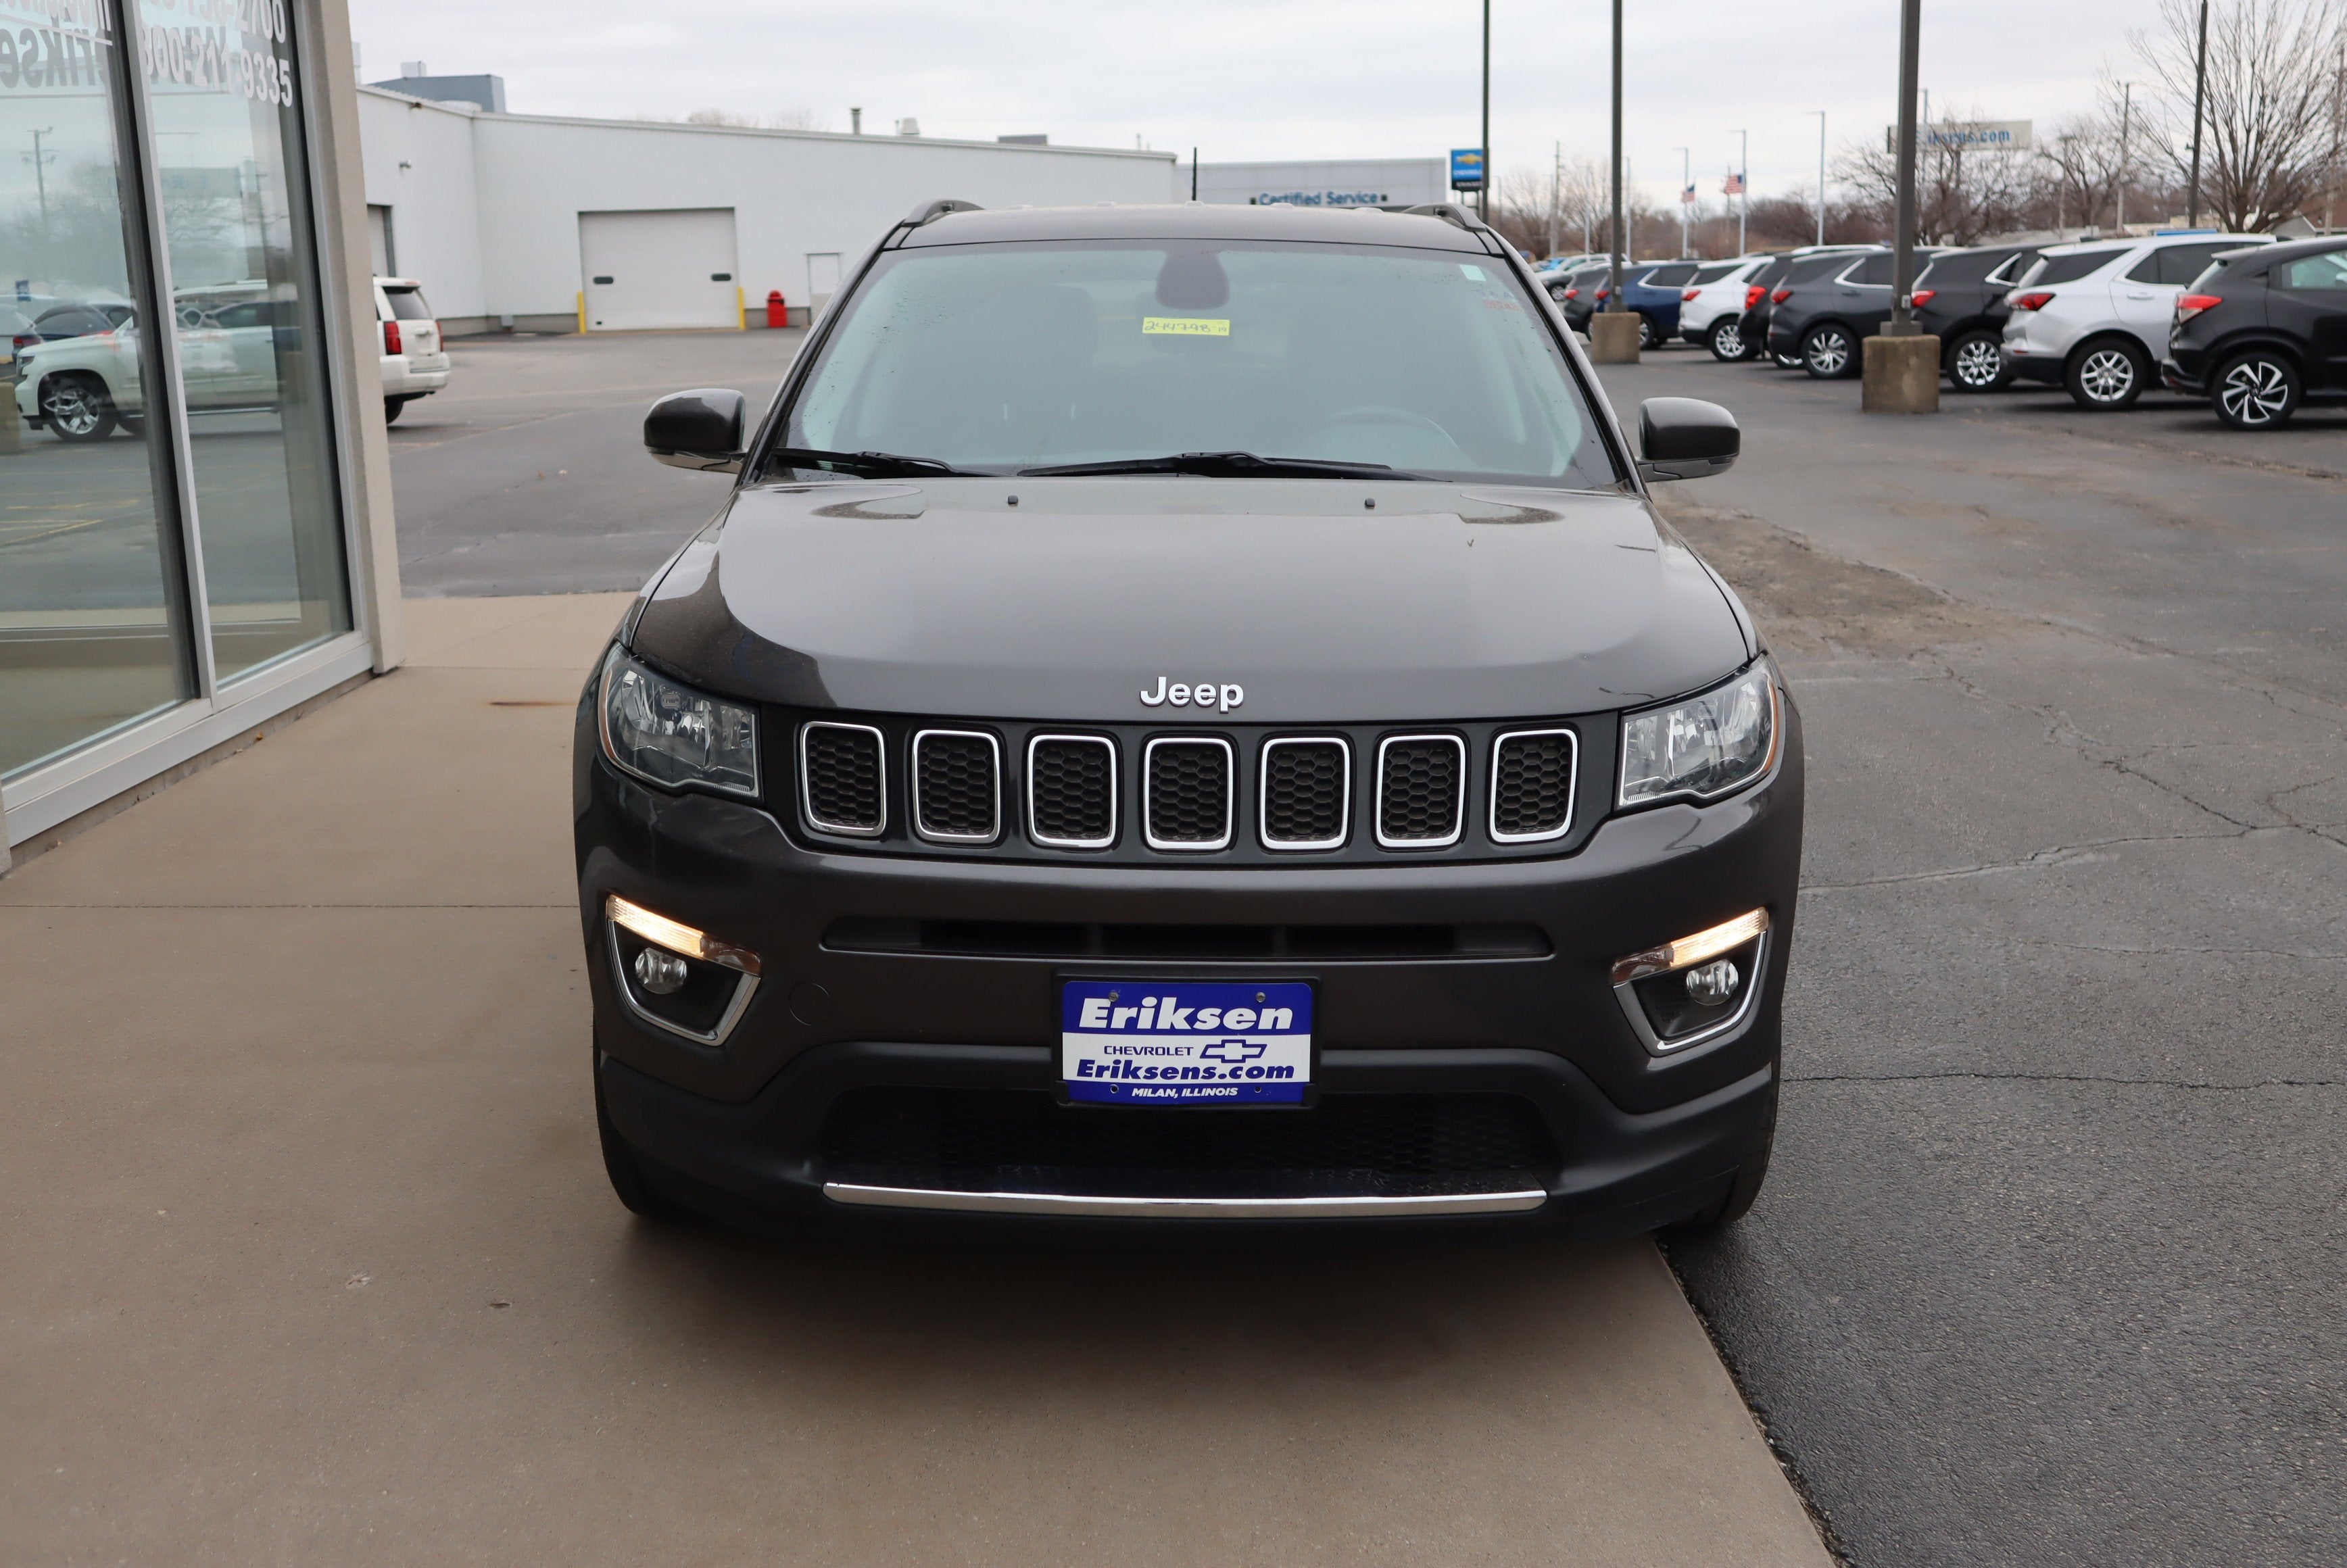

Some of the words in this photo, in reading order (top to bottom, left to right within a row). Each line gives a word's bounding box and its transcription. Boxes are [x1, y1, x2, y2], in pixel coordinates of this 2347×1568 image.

[1259, 191, 1321, 205] Certified
[1326, 191, 1378, 205] Service
[1140, 676, 1244, 714] Jeep
[1079, 996, 1293, 1030] Eriksen
[1104, 1046, 1194, 1056] CHEVROLET
[1076, 1059, 1295, 1081] Eriksens.com
[1131, 1087, 1179, 1099] MILAN,
[1181, 1087, 1238, 1097] ILLINOIS
